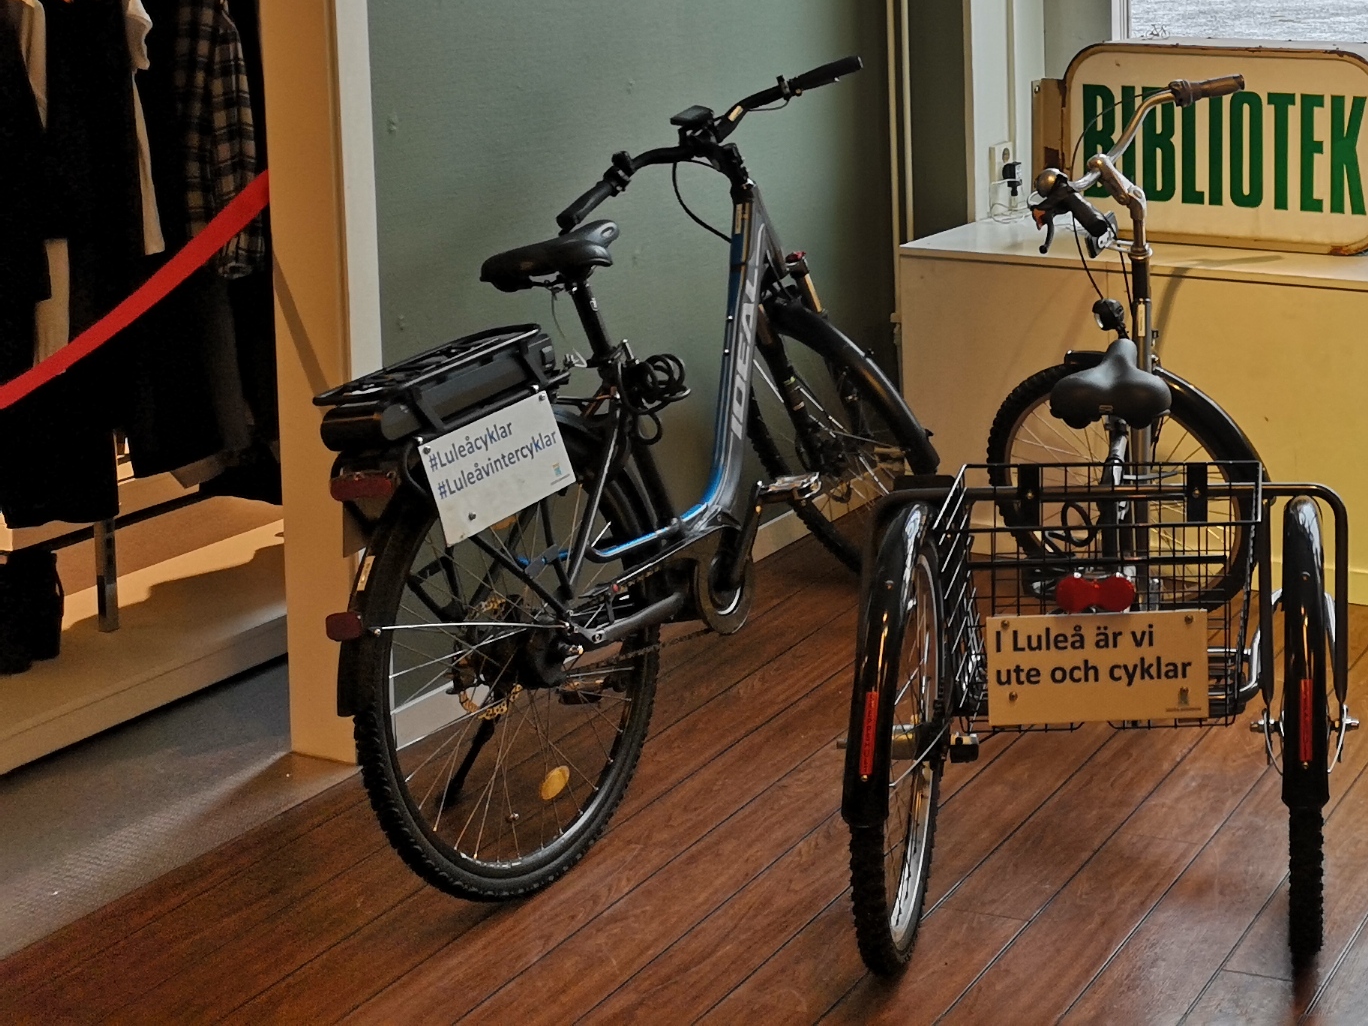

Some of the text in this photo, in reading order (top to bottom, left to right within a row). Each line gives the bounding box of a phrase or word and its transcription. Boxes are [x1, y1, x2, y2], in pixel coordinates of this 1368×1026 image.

[1082, 83, 1367, 215] BIBLIOTEK
[731, 259, 759, 440] IDEAL
[429, 422, 513, 472] #Luleåcyklar
[438, 431, 557, 500] #Luleåvintercyklar
[995, 624, 1154, 653] I Luleå är vi
[996, 657, 1192, 687] ute och cyklar
